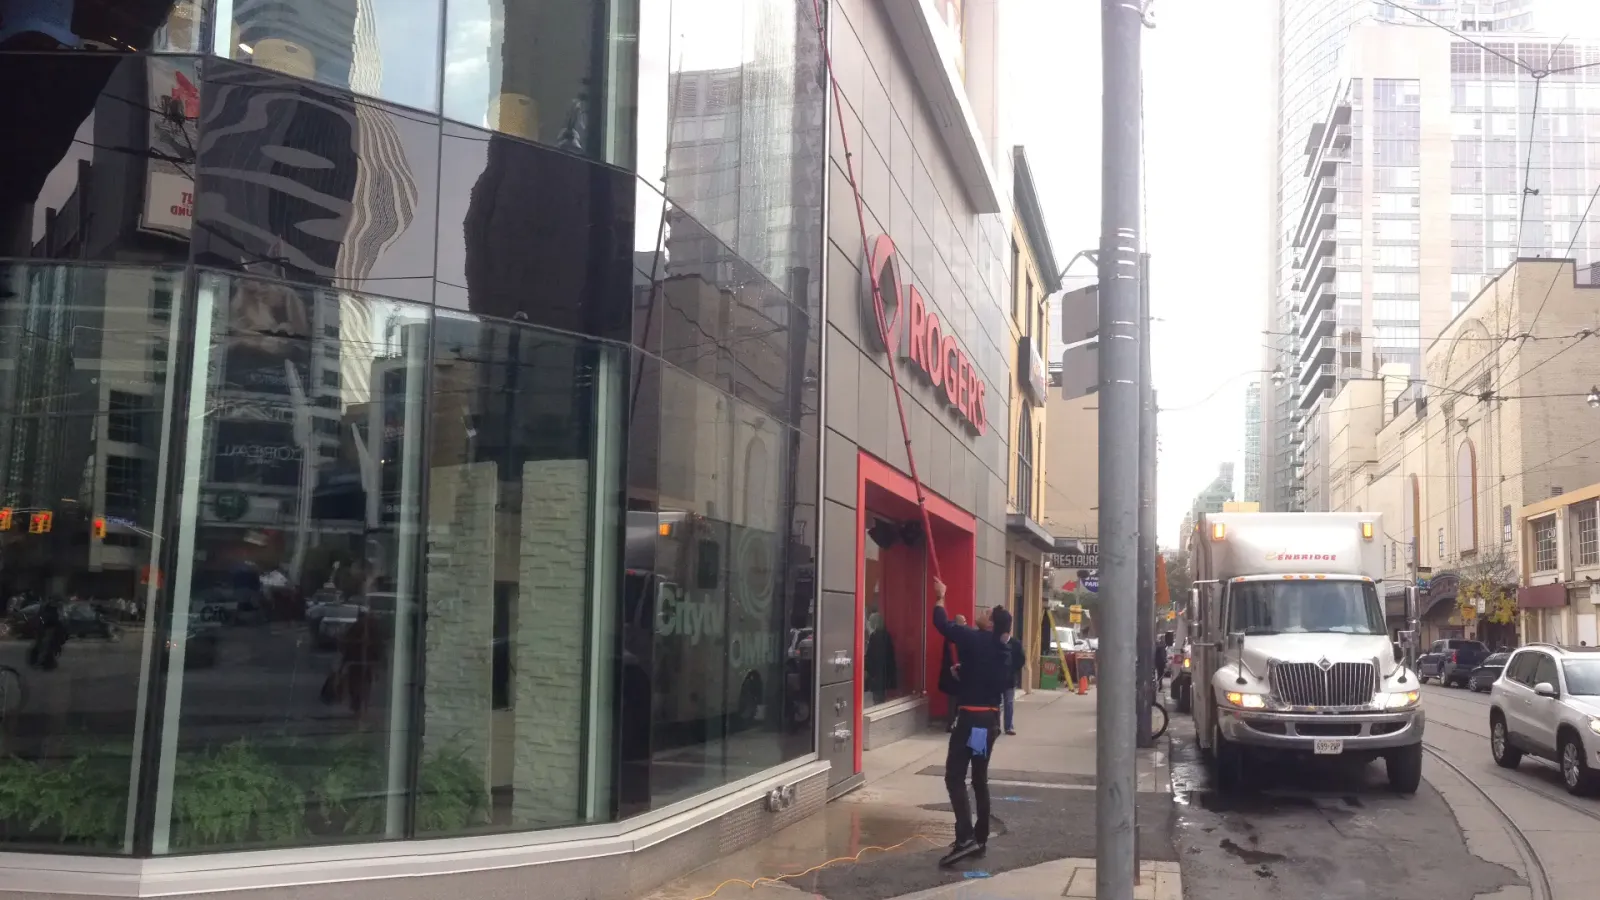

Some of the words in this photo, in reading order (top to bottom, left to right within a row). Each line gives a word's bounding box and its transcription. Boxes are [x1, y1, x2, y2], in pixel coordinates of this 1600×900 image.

[909, 283, 986, 436] ROGERS
[1277, 553, 1337, 561] ENBRIDGE
[656, 586, 724, 646] Citytv
